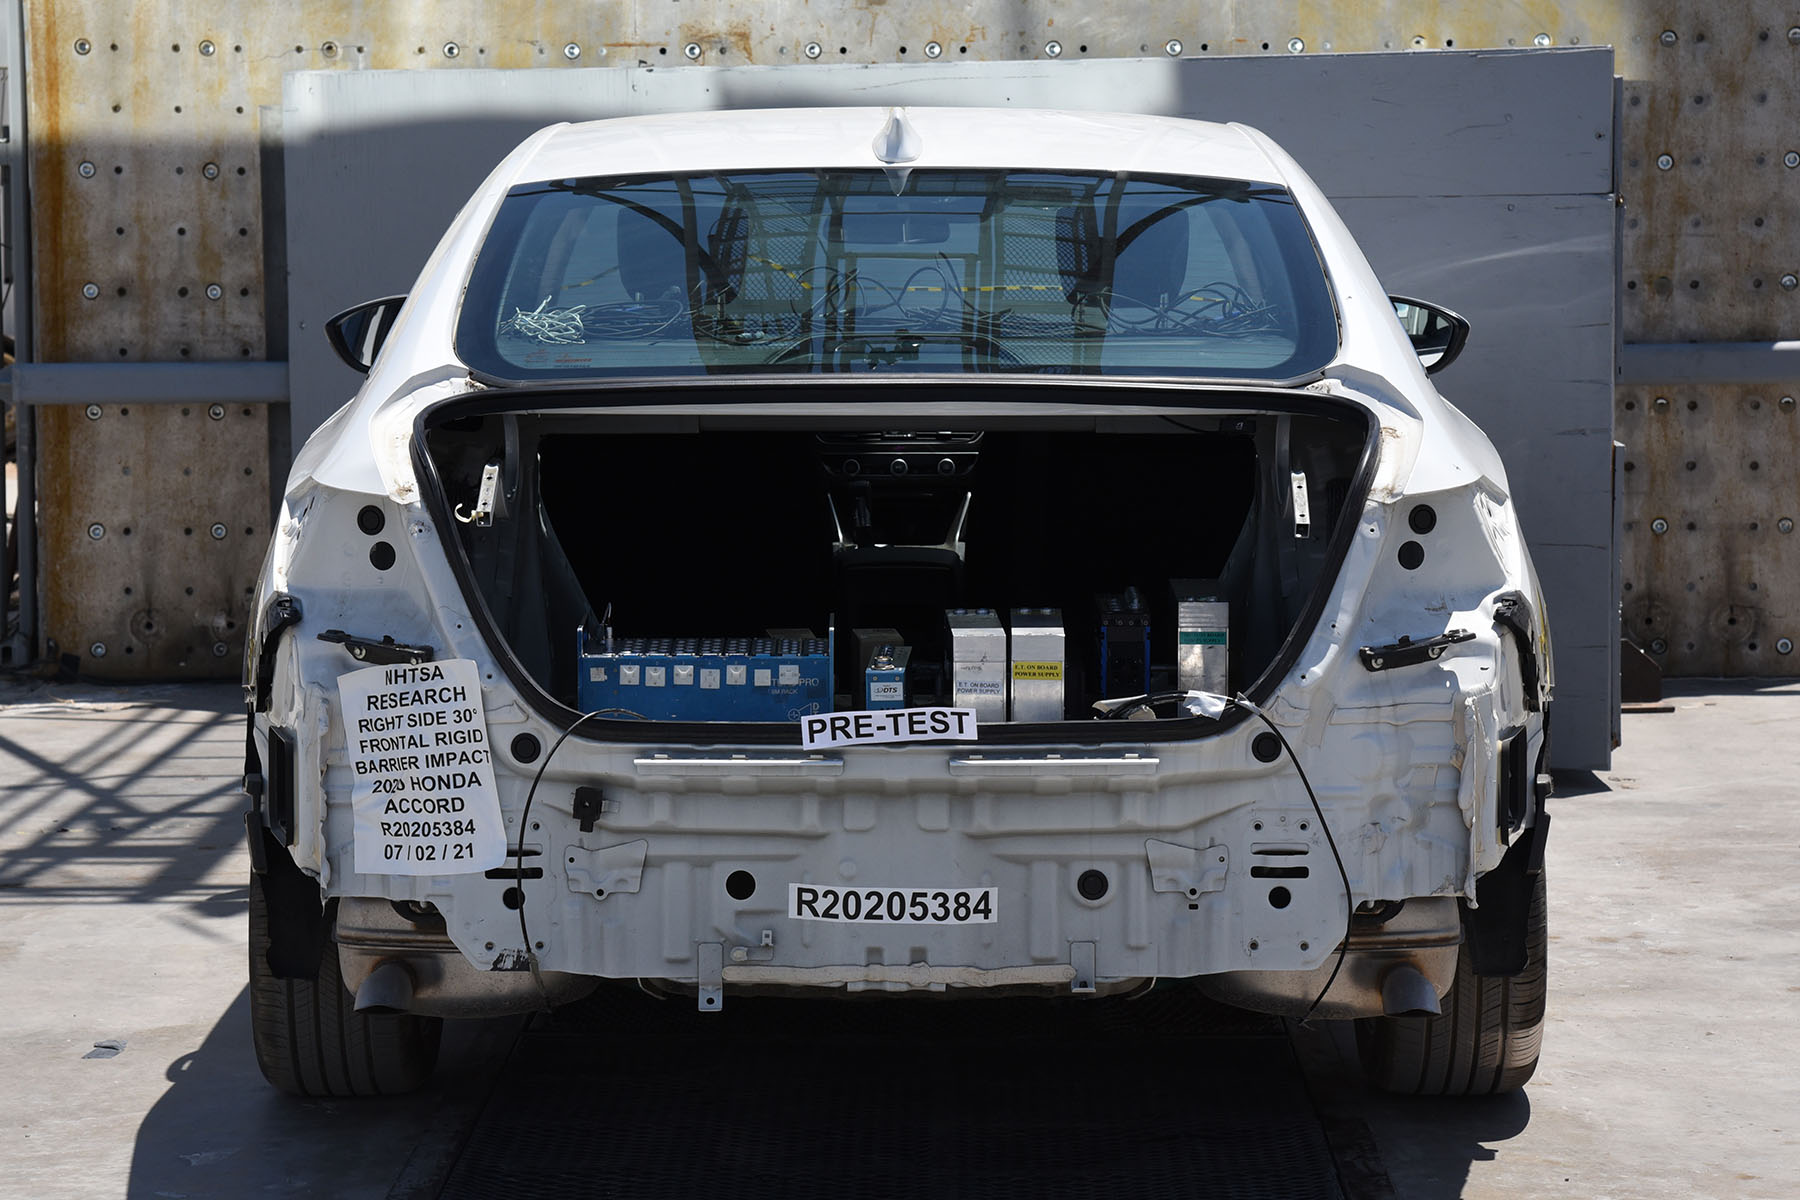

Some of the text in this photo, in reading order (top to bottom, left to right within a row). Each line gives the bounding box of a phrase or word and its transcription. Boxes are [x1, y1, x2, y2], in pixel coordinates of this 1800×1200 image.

[385, 665, 444, 686] NHTSA
[799, 678, 820, 686] PRO
[367, 686, 466, 711] RESEARCH
[358, 716, 404, 733] RIGHT
[407, 711, 447, 728] SIDE
[808, 711, 969, 743] PRE-TEST
[360, 729, 483, 753] FRONTAL RIGID
[356, 750, 490, 774] BARRIER IMPACT
[411, 772, 482, 791] HONDA
[384, 797, 465, 814] ACCORD
[381, 819, 475, 837] R20205384
[797, 887, 991, 921] R20205384
